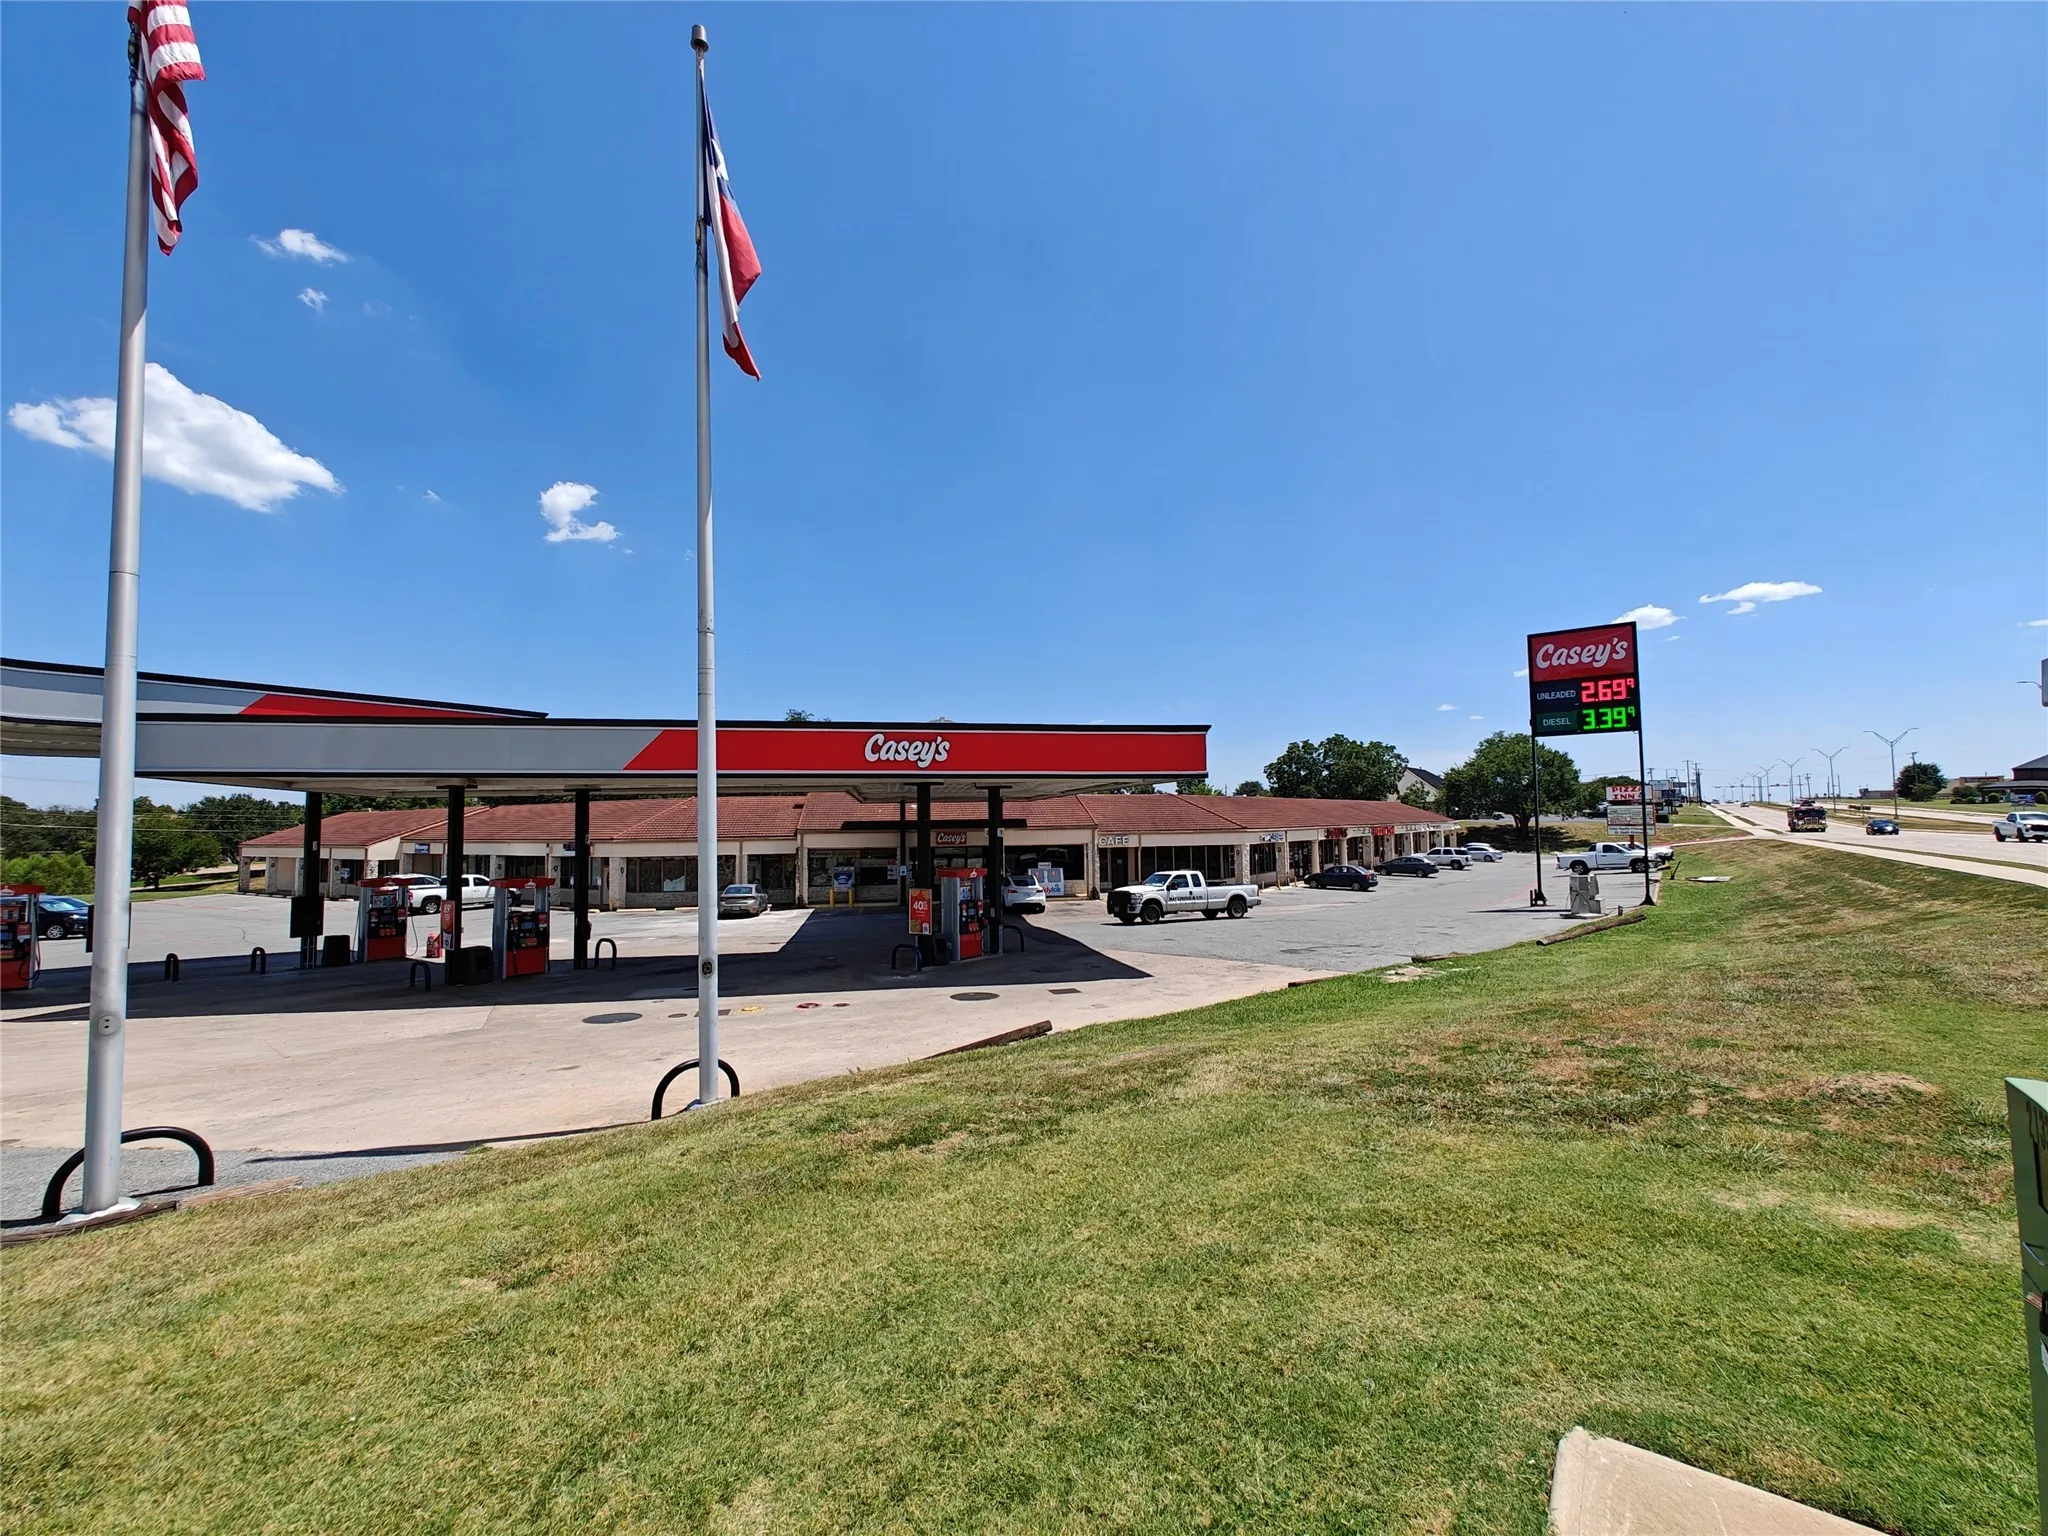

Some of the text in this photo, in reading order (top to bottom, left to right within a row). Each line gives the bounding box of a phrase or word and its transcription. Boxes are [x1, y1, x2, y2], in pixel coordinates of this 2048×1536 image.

[1536, 637, 1628, 669] Casey's
[1536, 690, 1576, 700] UNLEADED
[1543, 717, 1572, 726] DIESEL
[864, 733, 950, 768] Casey's
[937, 832, 966, 844] Casey's
[1099, 836, 1129, 846] CAFE
